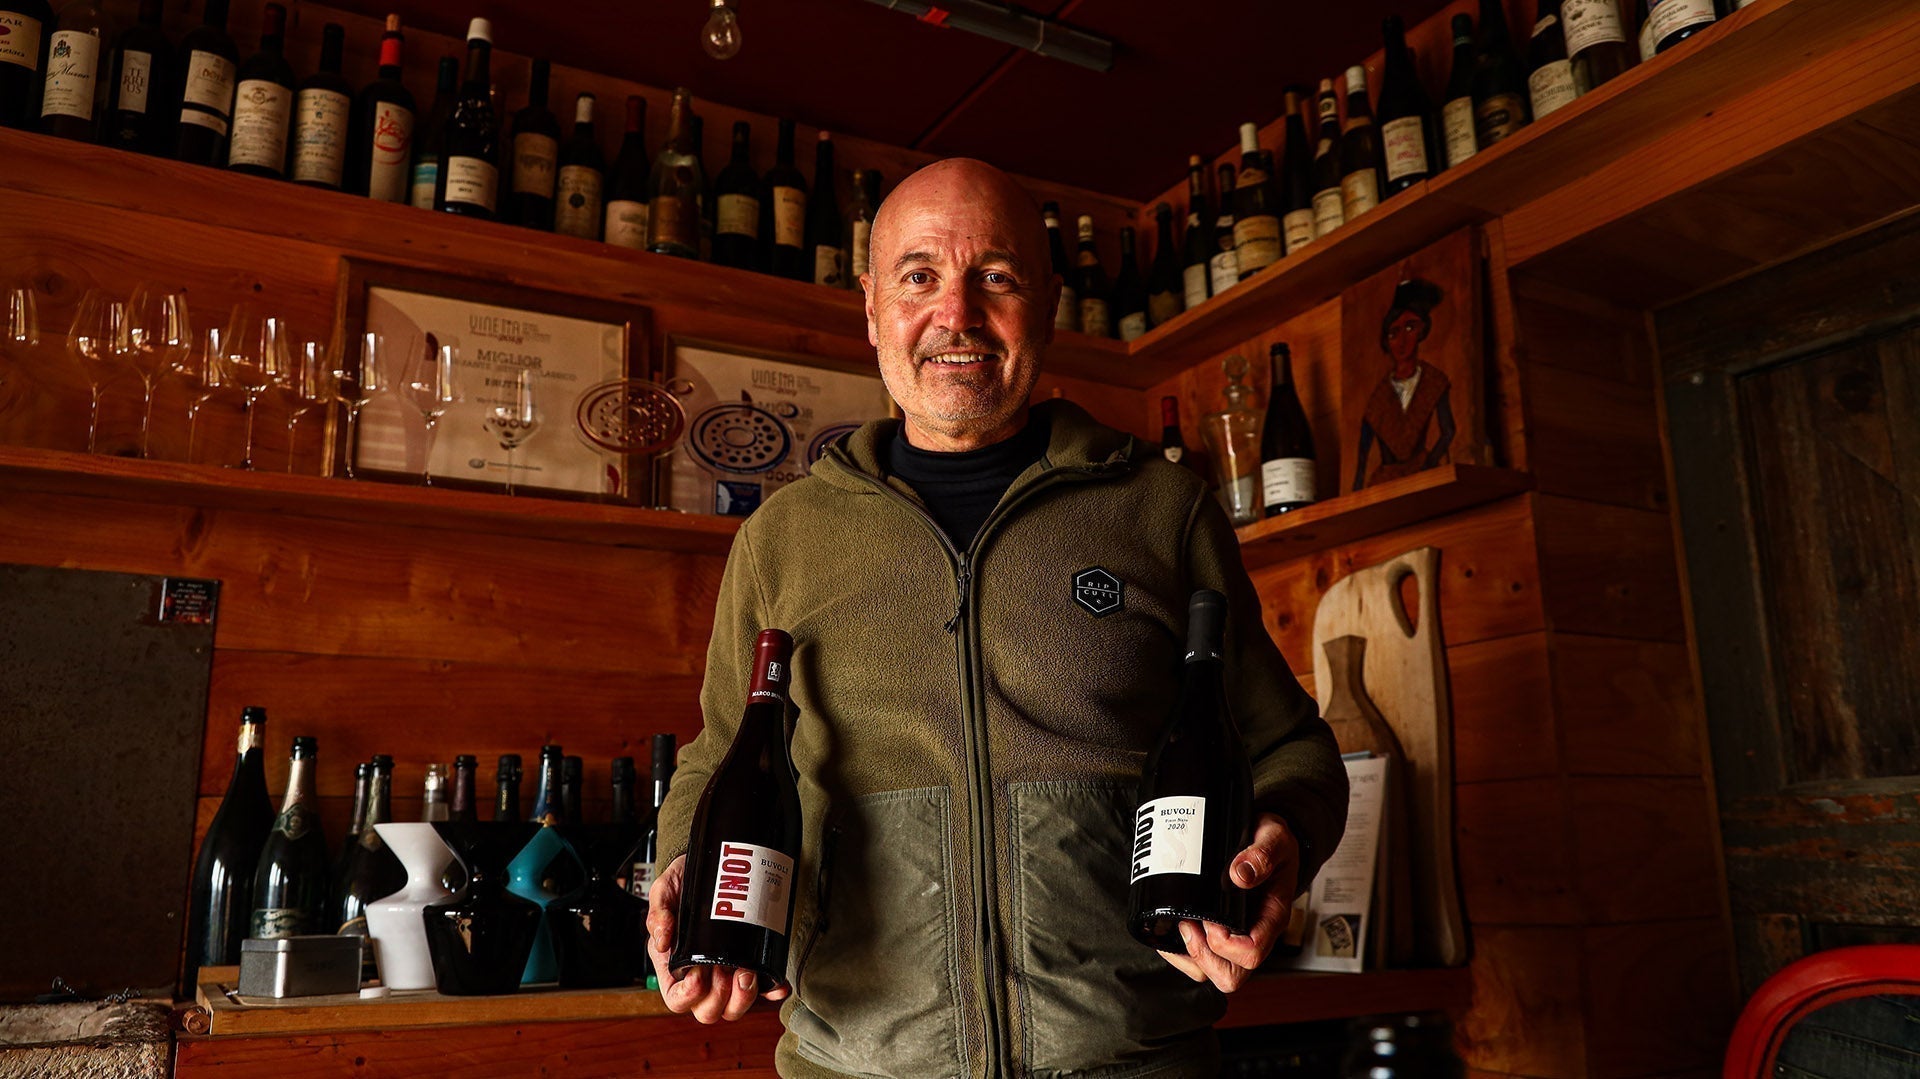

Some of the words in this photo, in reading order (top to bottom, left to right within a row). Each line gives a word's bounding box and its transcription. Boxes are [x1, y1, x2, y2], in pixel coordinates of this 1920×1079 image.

[477, 349, 542, 369] MIGLIOR
[1087, 581, 1109, 589] RIP
[752, 690, 771, 698] MARCO
[1160, 808, 1196, 816] BUVOLI
[1132, 806, 1154, 879] PINOT
[761, 858, 788, 875] BUVOLI
[715, 845, 753, 918] PINOT
